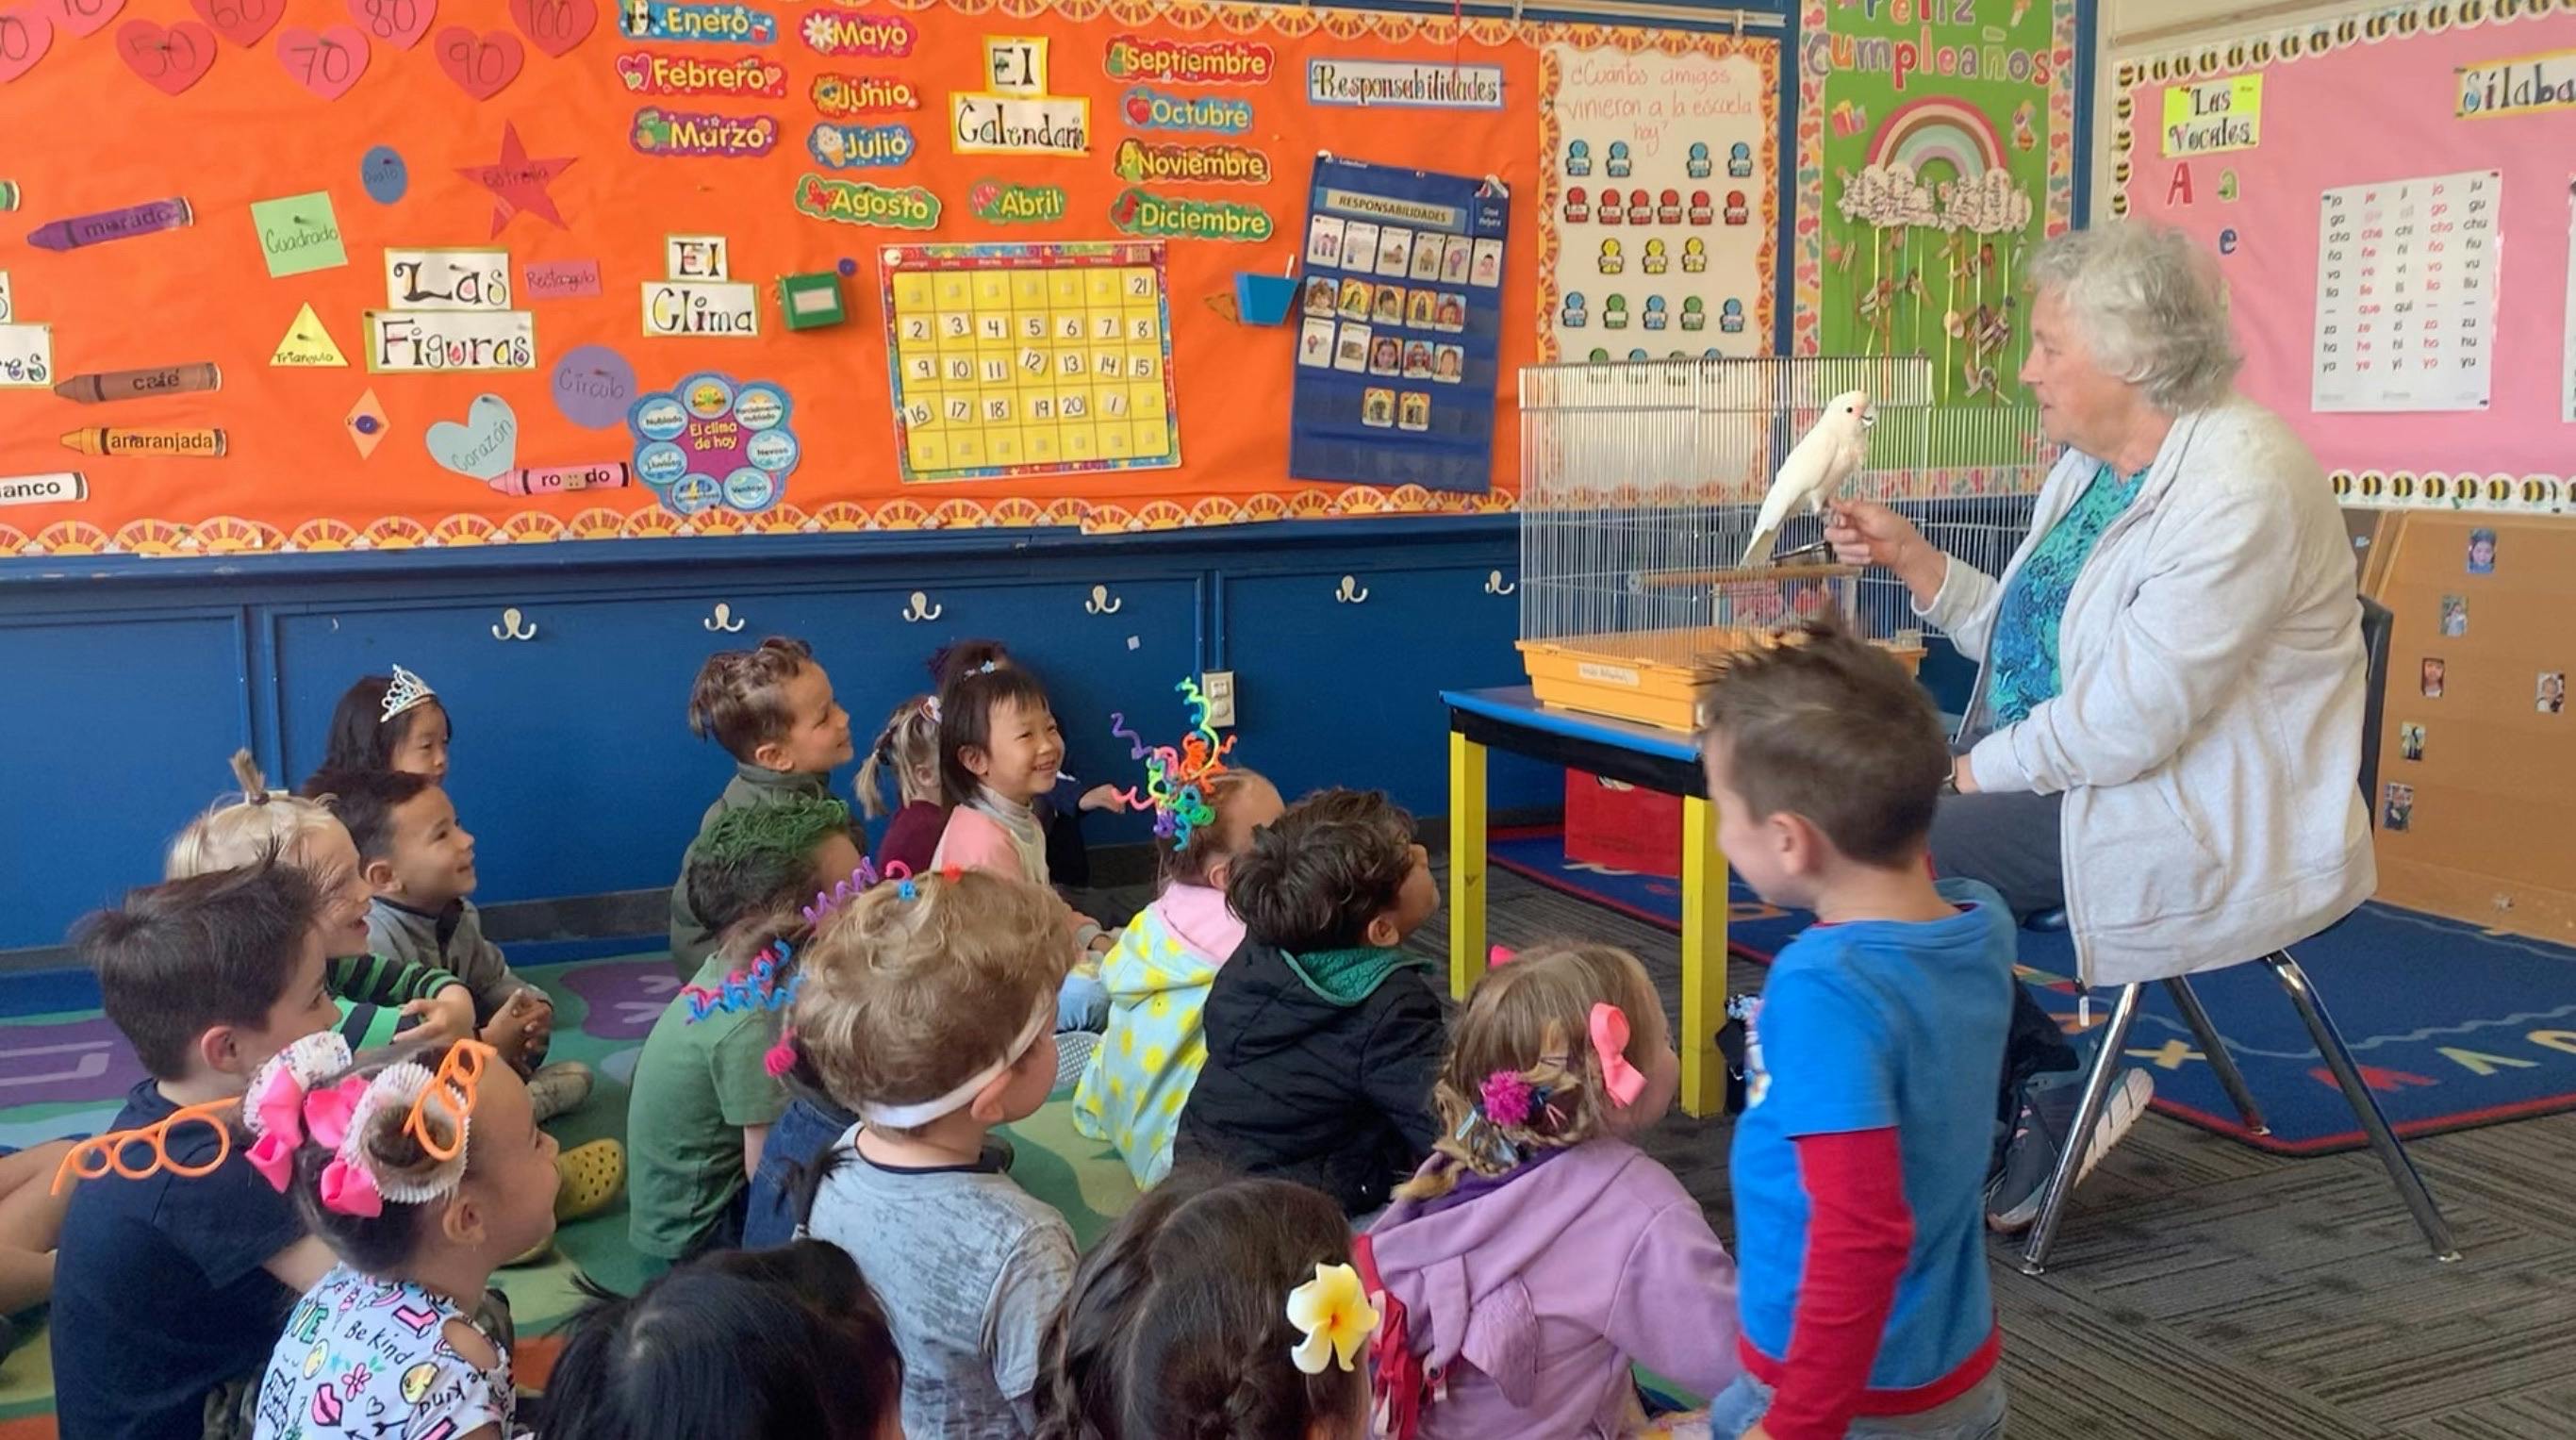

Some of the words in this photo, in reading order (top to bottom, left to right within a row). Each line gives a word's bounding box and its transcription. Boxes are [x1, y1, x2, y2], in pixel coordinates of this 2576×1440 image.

[667, 8, 750, 35] Enero
[833, 21, 907, 48] Mayo
[0, 16, 29, 60] 0
[129, 29, 196, 77] 50
[289, 42, 350, 86] 70
[449, 41, 504, 85] 90
[992, 47, 1034, 86] El
[1127, 46, 1266, 75] Septiembre
[1807, 25, 2050, 91] Cumpleaños
[653, 58, 766, 90] Febrero
[1313, 65, 1496, 104] Responsabilidades
[835, 84, 910, 109] Junio
[2190, 89, 2231, 116] Las
[1152, 99, 1248, 127] Octubre
[671, 121, 766, 150] Marzo
[846, 134, 907, 160] Julio
[2169, 117, 2250, 151] Vocales
[1139, 149, 1263, 174] Noviembre
[2167, 162, 2192, 205] A
[832, 190, 929, 220] Agosto
[1000, 190, 1061, 217] Abril
[1141, 203, 1266, 233] Diciembre
[1339, 195, 1446, 222] RESPONSABILIDADES
[85, 208, 171, 238] morado
[266, 223, 338, 255] Cuadrado
[673, 241, 718, 276] El
[393, 260, 508, 306] Las
[1134, 278, 1147, 294] 21
[653, 288, 751, 332] Clima
[913, 321, 922, 338] 2
[952, 317, 963, 334] 3
[988, 320, 999, 336] 4
[1030, 318, 1041, 335] 5
[1066, 320, 1077, 335] 6
[1102, 319, 1112, 335] 7
[1138, 320, 1148, 337] 8
[381, 319, 530, 368] Figuras
[0, 353, 46, 382] es
[918, 360, 930, 377] 9
[952, 361, 967, 378] 10
[988, 362, 1001, 377] 11
[1025, 351, 1041, 371] 12
[1064, 356, 1079, 372] 13
[1100, 356, 1115, 373] 14
[1135, 359, 1148, 375] 15
[910, 404, 928, 422] 16
[951, 401, 966, 417] 17
[990, 401, 1004, 416] 18
[1034, 400, 1049, 415] 19
[1063, 397, 1082, 414] 20
[1111, 398, 1116, 411] 1
[690, 424, 702, 437] El
[705, 422, 737, 434] clima
[695, 439, 710, 451] de
[715, 437, 737, 450] hoy
[452, 420, 512, 472] Corazón
[0, 482, 60, 498] anco
[345, 1319, 367, 1341] Be
[367, 1329, 415, 1365] kind
[419, 1380, 466, 1416] kind
